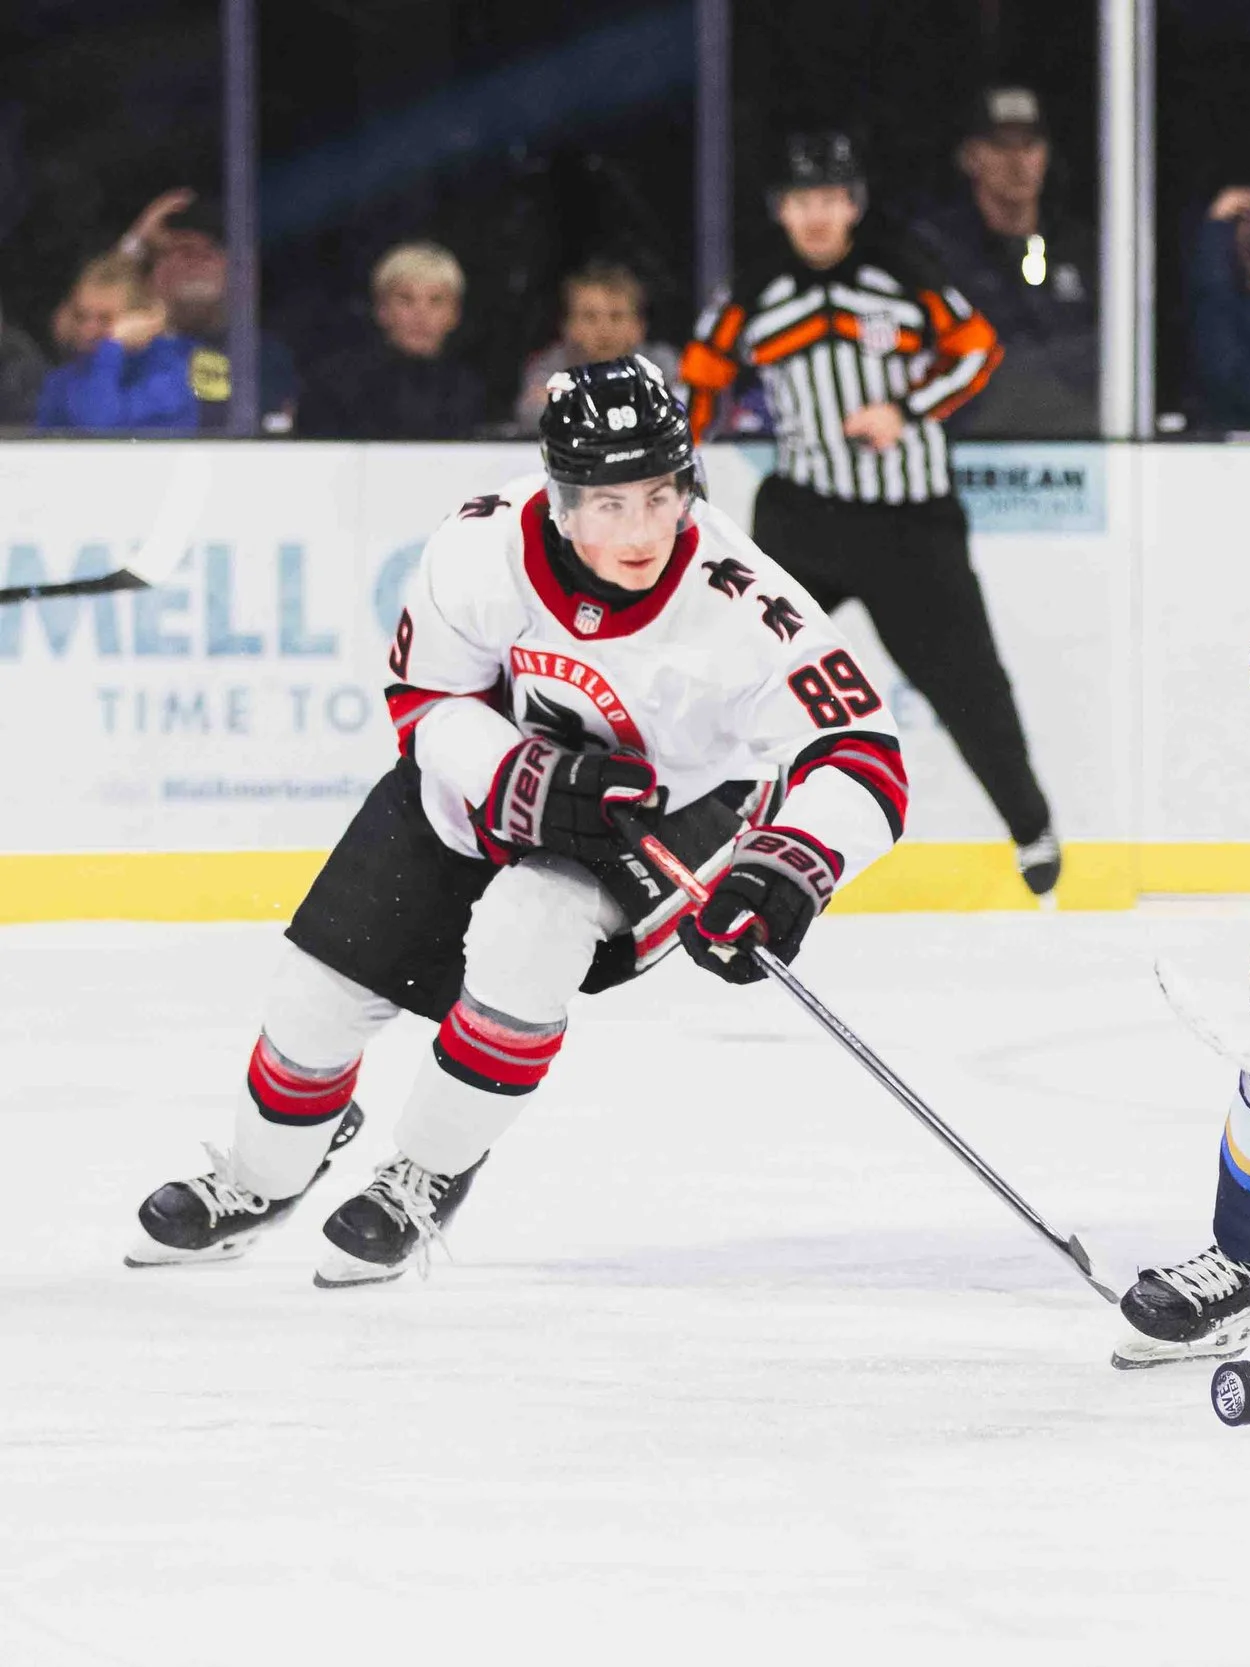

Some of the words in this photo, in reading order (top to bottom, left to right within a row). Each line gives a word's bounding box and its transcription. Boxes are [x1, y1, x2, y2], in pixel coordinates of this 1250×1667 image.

[607, 405, 638, 431] 89
[97, 684, 250, 733] TIME
[290, 684, 372, 733] TO
[787, 648, 882, 729] 89
